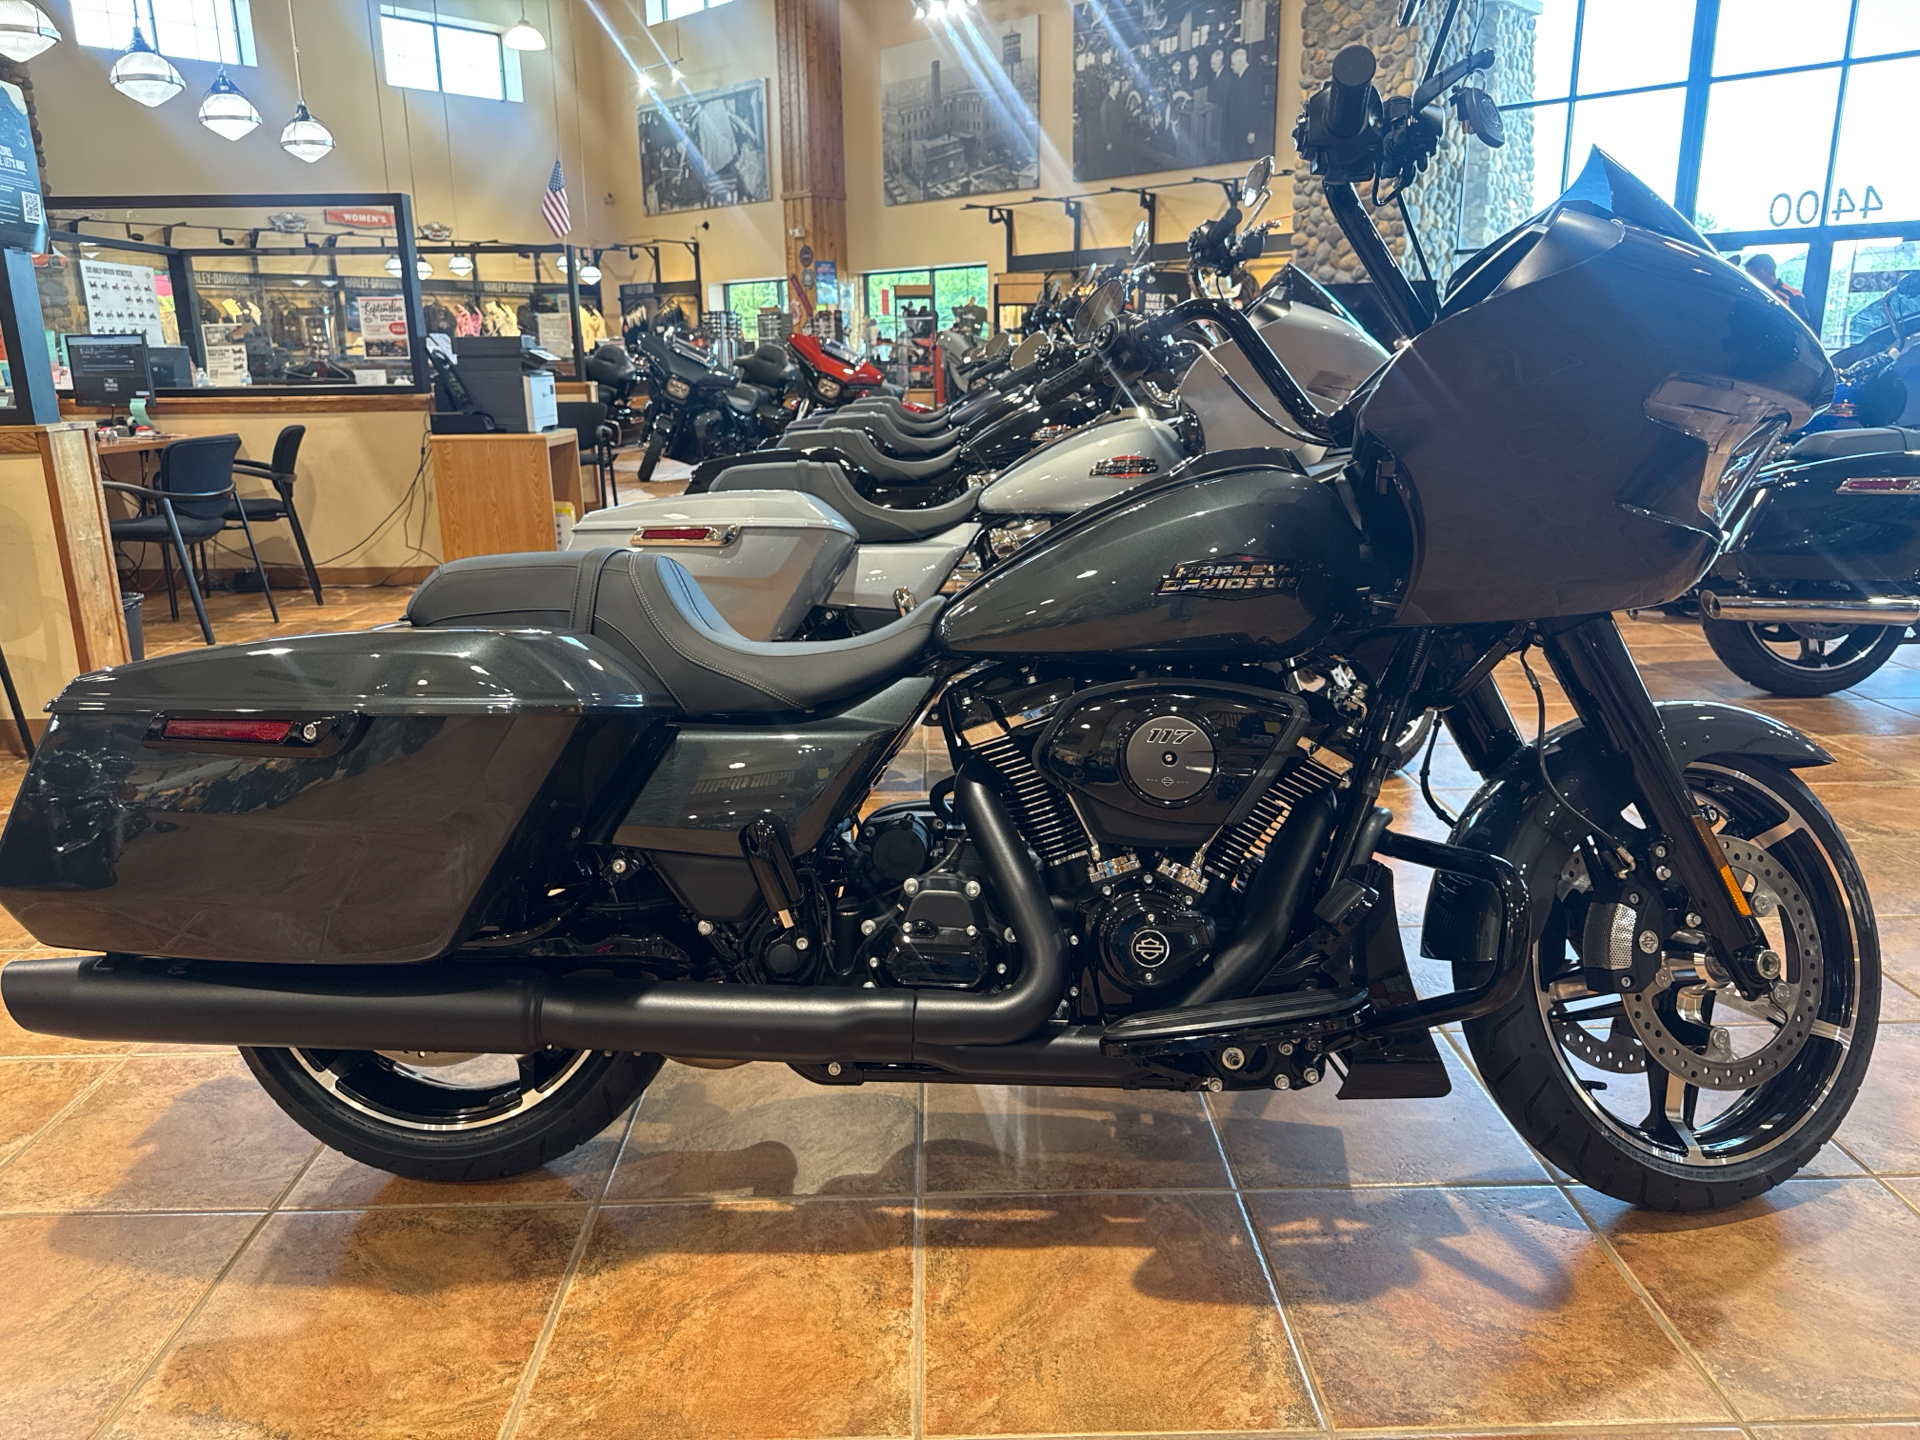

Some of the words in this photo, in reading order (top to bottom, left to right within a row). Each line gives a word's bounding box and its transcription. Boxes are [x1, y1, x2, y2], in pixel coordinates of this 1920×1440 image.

[343, 213, 387, 224] WOMEN'S
[364, 299, 404, 319] September
[1160, 577, 1297, 592] DAVIDSON
[1146, 728, 1197, 745] 117
